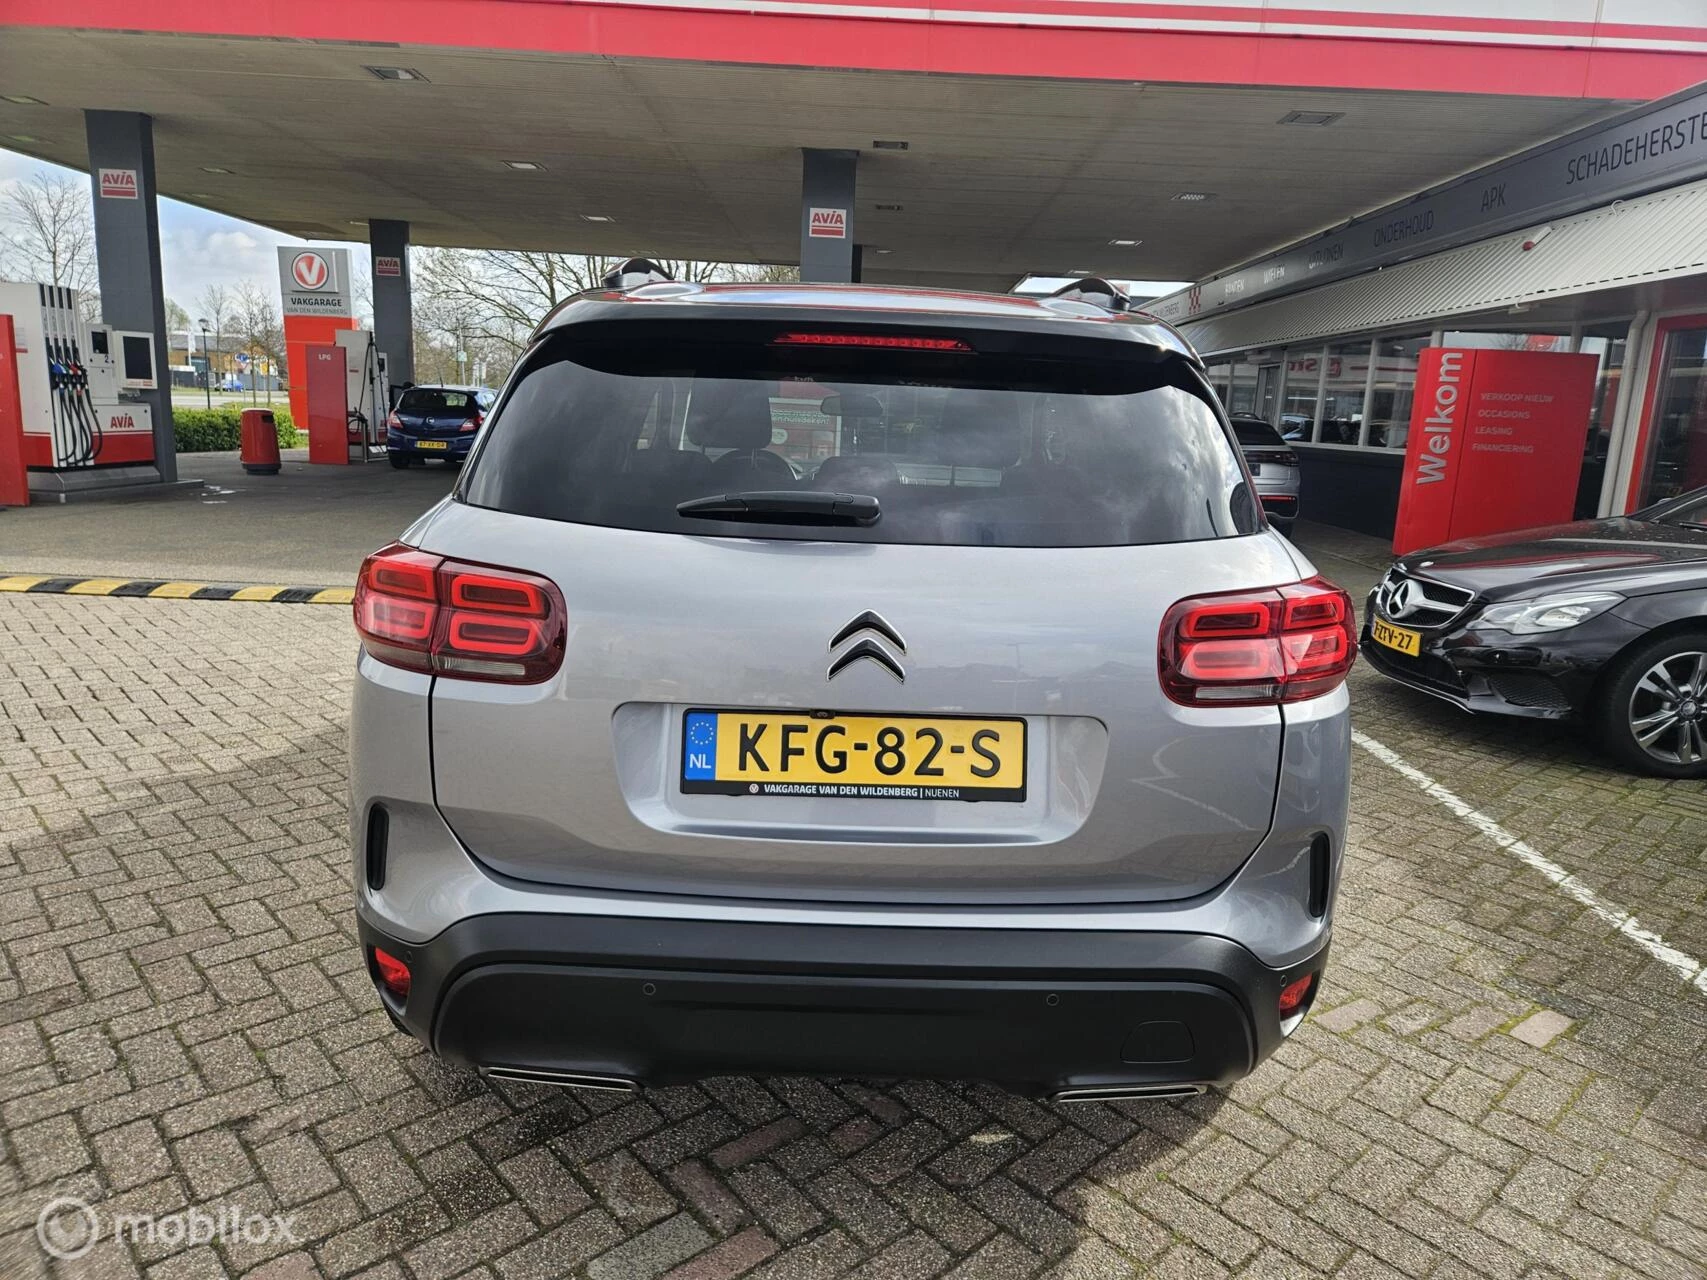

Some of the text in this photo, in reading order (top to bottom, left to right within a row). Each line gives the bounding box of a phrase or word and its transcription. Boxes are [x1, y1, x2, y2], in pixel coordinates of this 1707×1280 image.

[102, 171, 136, 186] AVIA
[1481, 183, 1506, 213] APK
[811, 210, 844, 225] AVIA
[1374, 209, 1434, 248] ONDERHOUD
[377, 258, 399, 268] AVIA
[290, 297, 342, 307] VAKGARAGE
[1480, 392, 1553, 403] VERKOOP NIEUW
[110, 413, 135, 429] AVIA
[1416, 352, 1463, 485] Welkom
[1478, 409, 1531, 419] OCCASIONS
[1475, 426, 1513, 436] LEASING
[1472, 443, 1534, 454] FINANCIERING
[738, 723, 1001, 778] KFG-82-S
[689, 753, 712, 769] NL
[764, 784, 960, 798] VAKGARAGE VAN DEN WILDENBERG NUENEN
